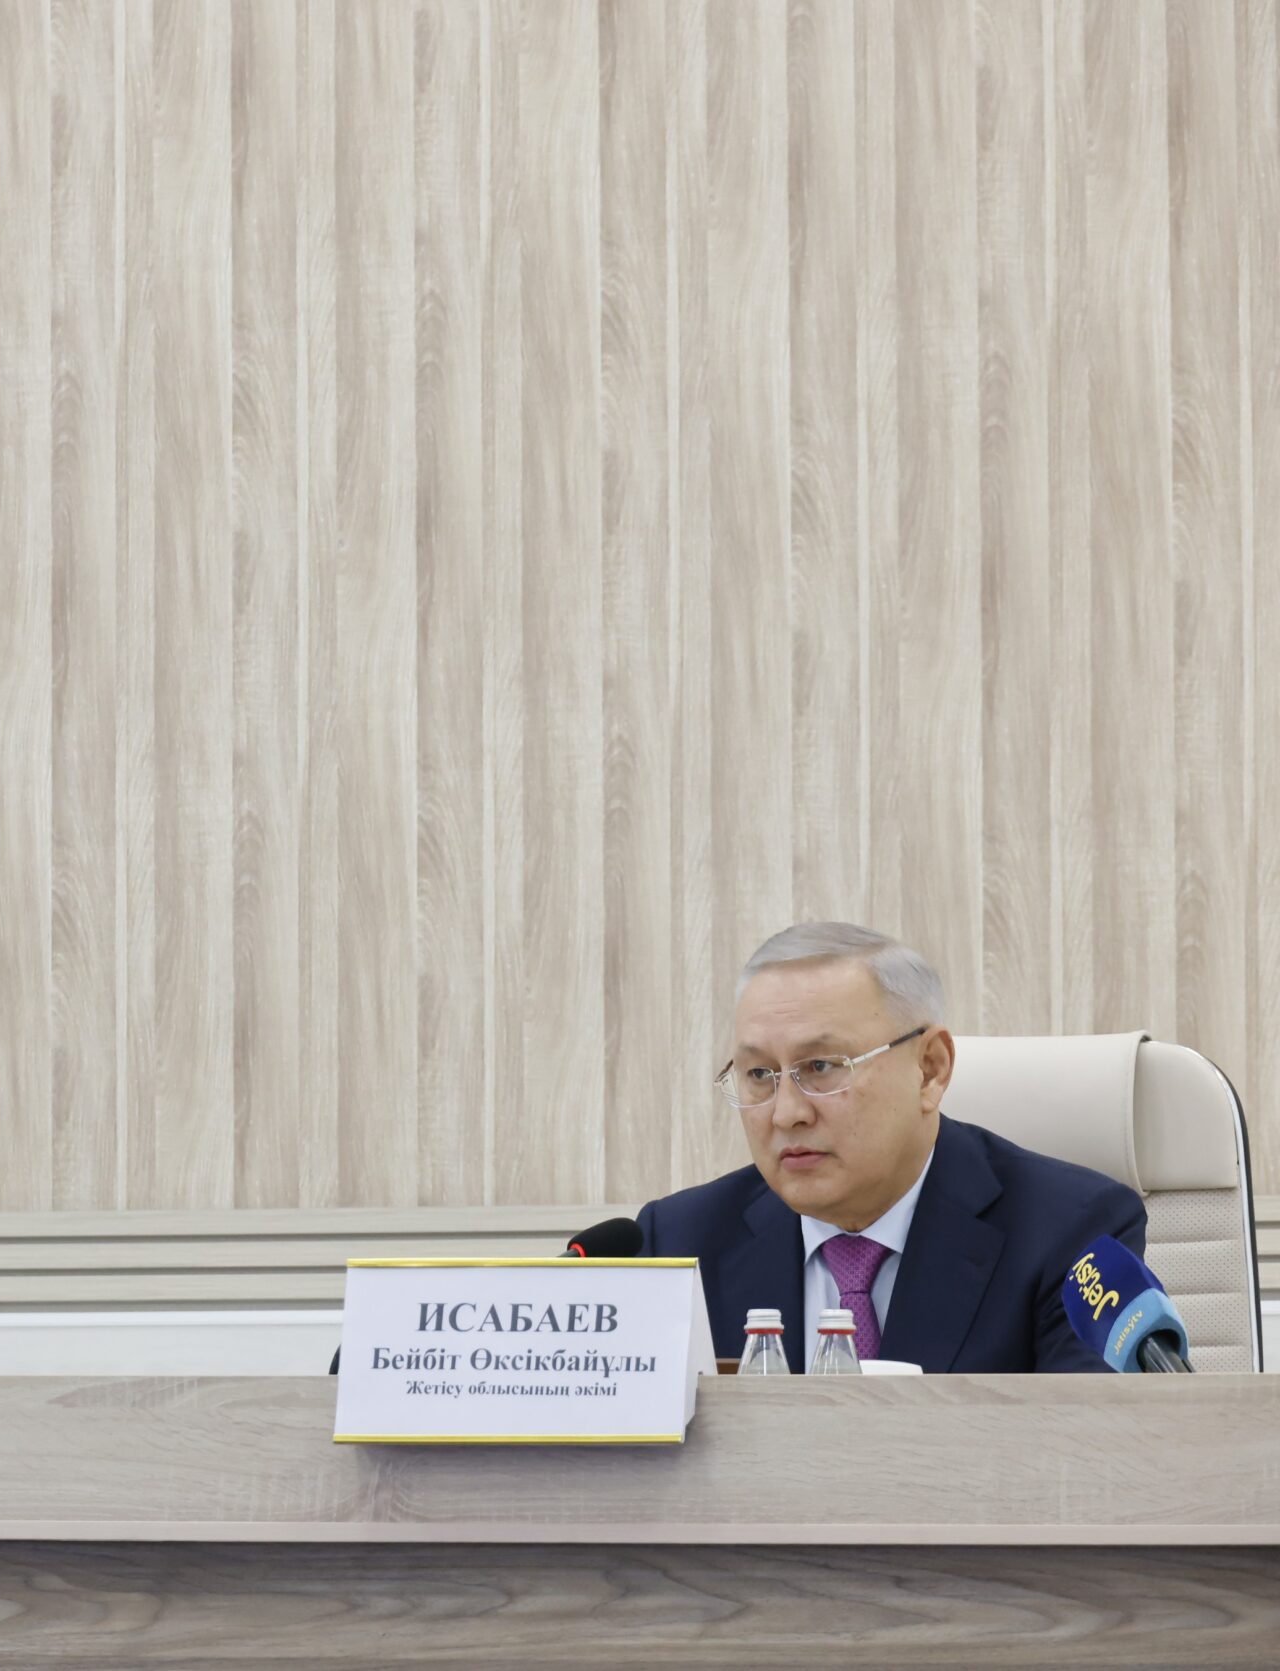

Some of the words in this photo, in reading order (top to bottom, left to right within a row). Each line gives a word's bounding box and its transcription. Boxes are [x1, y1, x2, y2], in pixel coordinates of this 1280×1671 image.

[417, 1303, 619, 1333] ИСАБАЕВ
[371, 1347, 462, 1370] Бейбіт
[470, 1348, 657, 1378] Өксікбайұлы
[406, 1380, 464, 1399] Жетісу
[468, 1380, 571, 1397] облысының
[574, 1382, 618, 1396] әкімі
